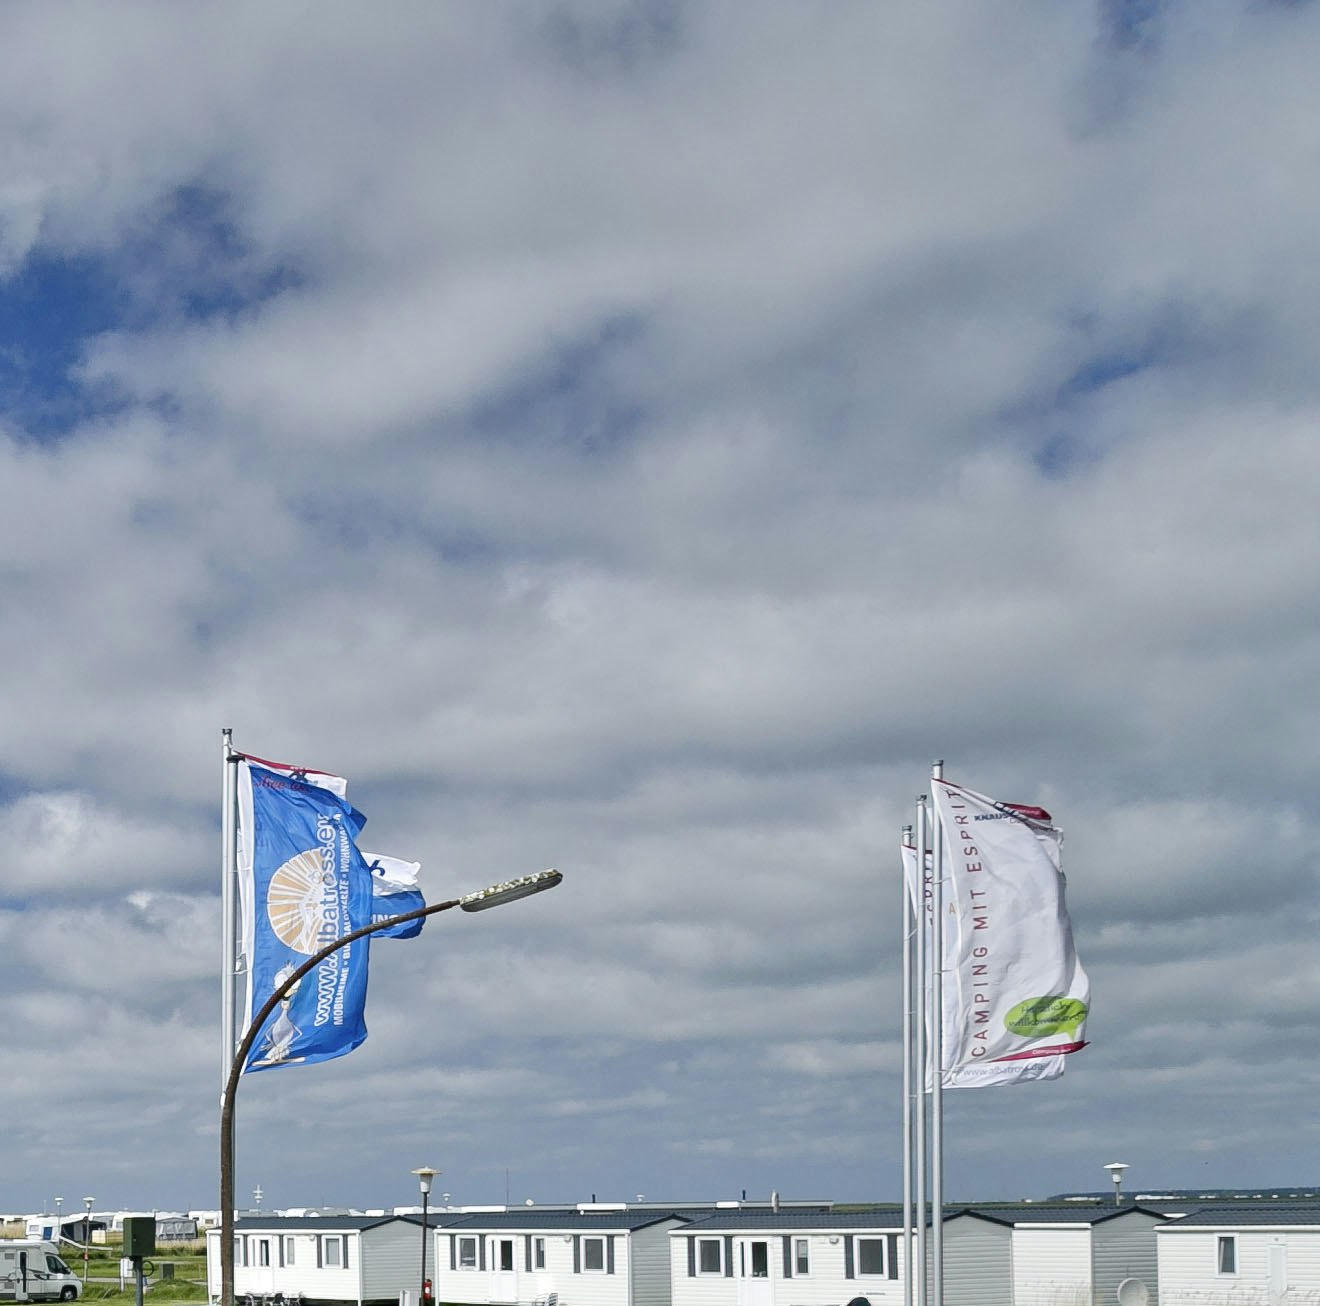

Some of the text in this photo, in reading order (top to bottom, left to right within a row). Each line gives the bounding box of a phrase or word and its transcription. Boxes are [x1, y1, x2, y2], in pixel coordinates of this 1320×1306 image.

[946, 788, 990, 1057] CAMPING MIT ESPRIT
